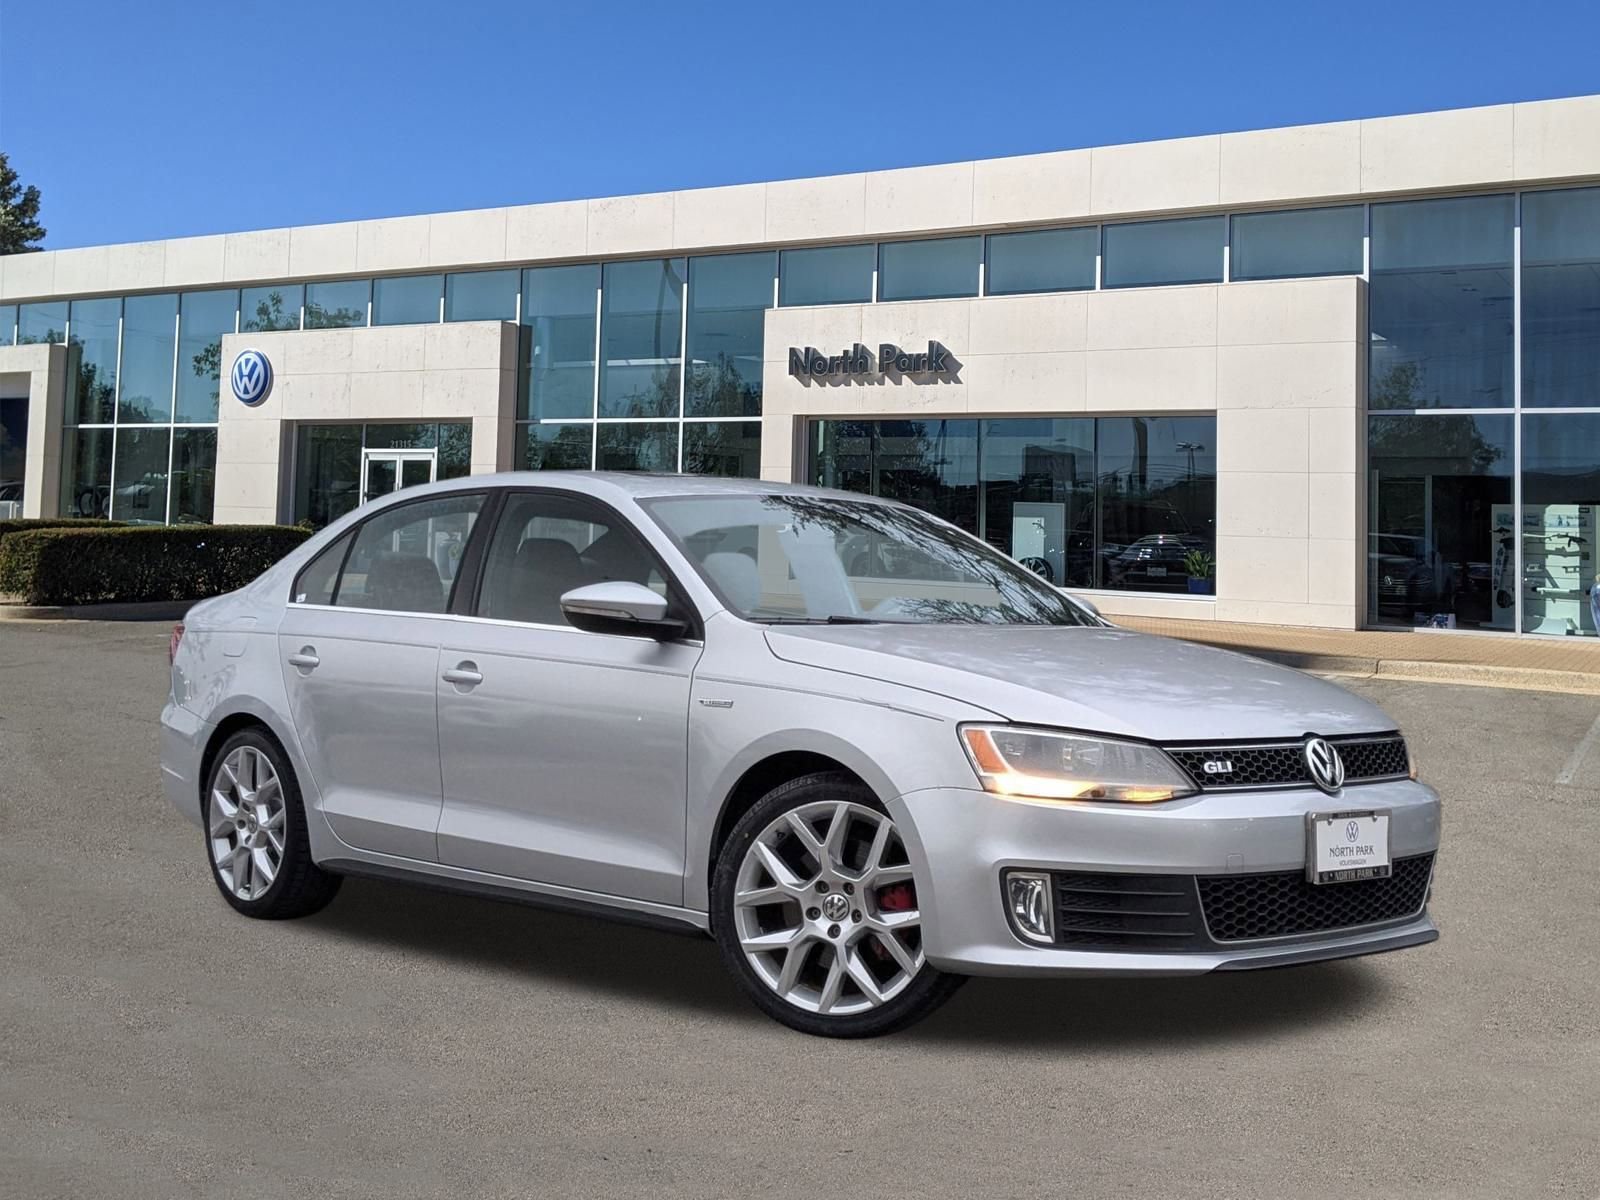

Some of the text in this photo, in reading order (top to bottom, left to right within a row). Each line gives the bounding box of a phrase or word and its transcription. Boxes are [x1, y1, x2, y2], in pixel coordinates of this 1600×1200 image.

[788, 340, 946, 375] North Park
[233, 352, 265, 400] VW
[1203, 760, 1233, 774] GLI
[1329, 845, 1375, 857] NORTH PARK
[1335, 868, 1374, 881] NORTH PARK
